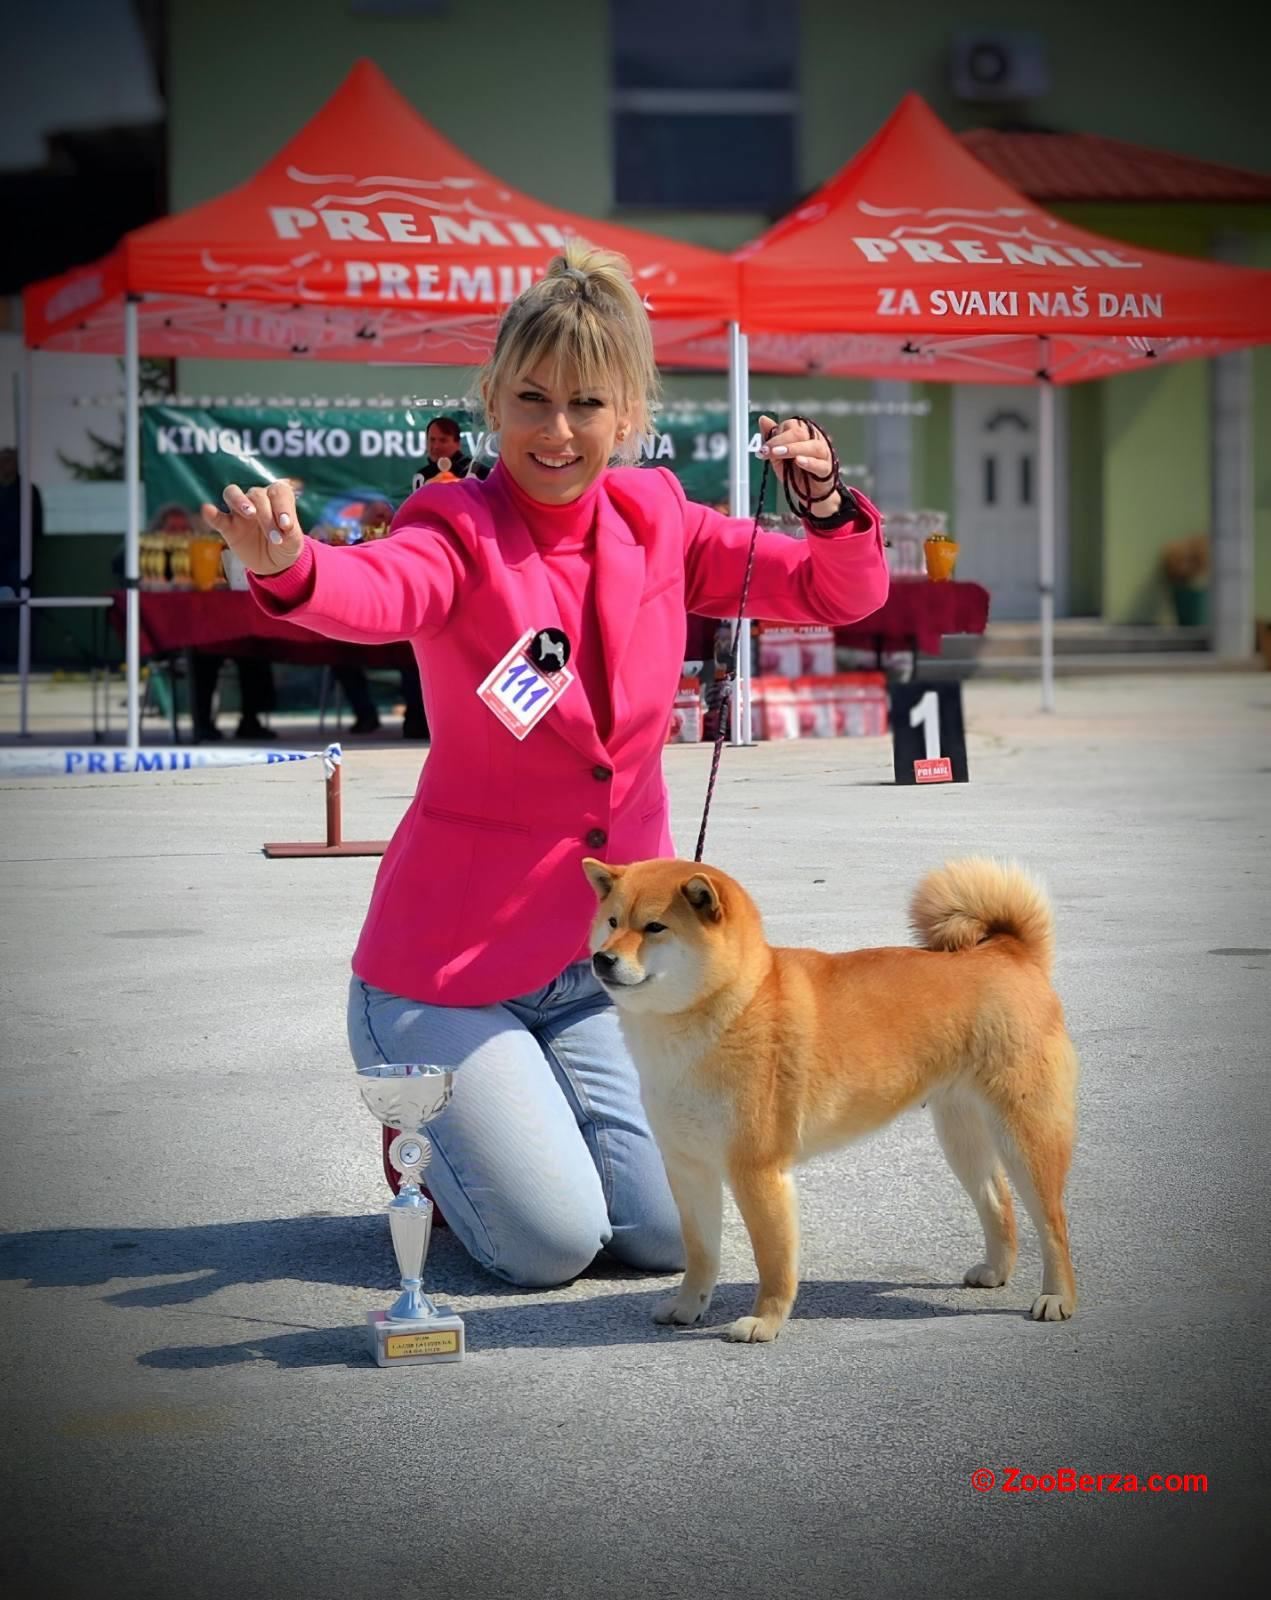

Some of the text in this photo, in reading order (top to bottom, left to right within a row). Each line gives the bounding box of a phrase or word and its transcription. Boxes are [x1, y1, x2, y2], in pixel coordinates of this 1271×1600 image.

[853, 236, 1143, 268] PREMIL
[876, 285, 1162, 319] ZA SVAKI NAŠ DAN
[157, 420, 351, 458] KINOLOŠKO
[693, 432, 768, 461] 194
[501, 663, 549, 712] 111
[910, 690, 940, 760] 1
